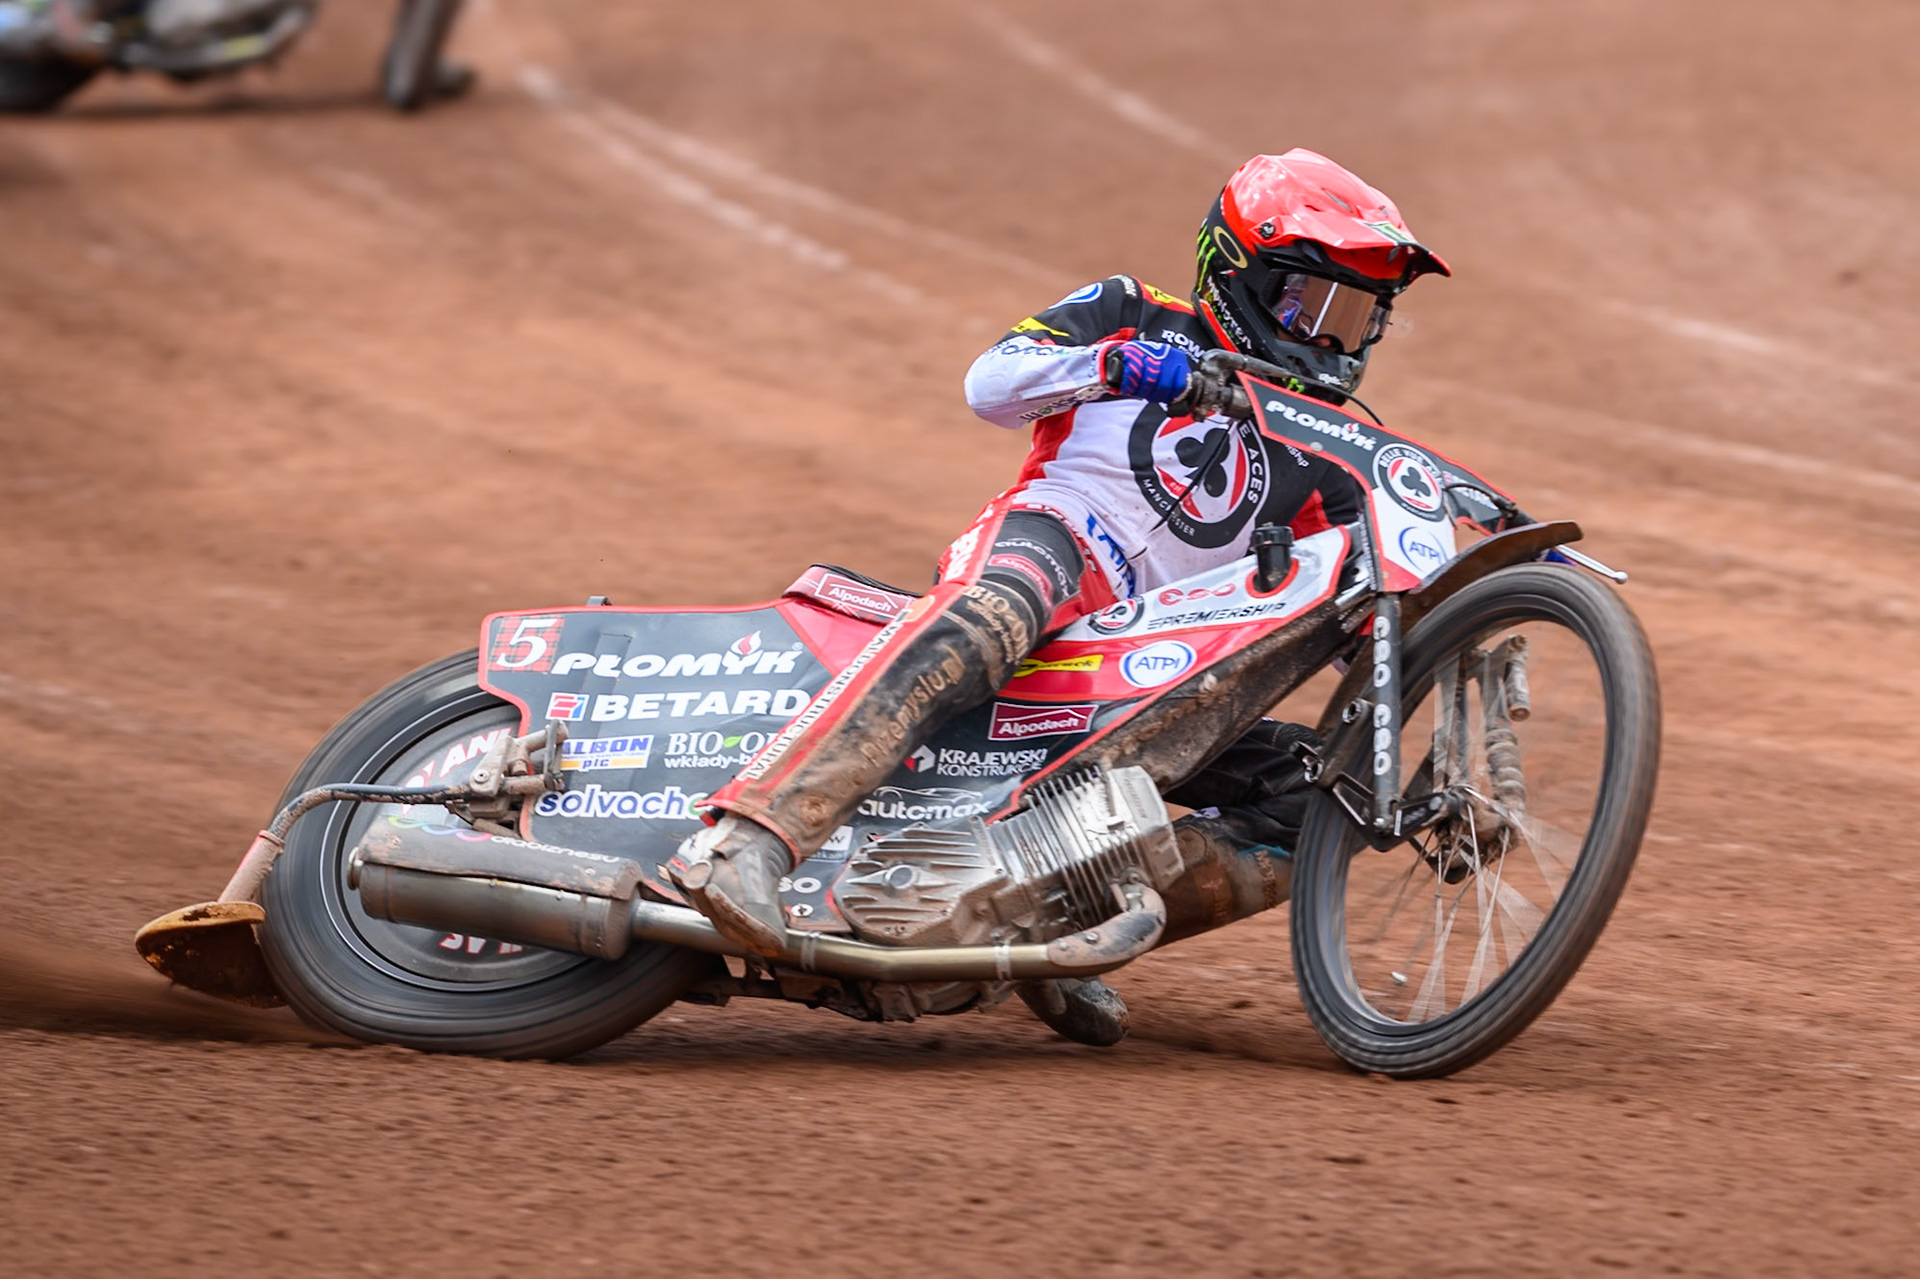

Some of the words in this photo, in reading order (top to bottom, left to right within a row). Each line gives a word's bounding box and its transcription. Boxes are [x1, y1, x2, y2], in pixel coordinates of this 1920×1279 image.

[1161, 329, 1205, 358] ROW
[1247, 447, 1264, 504] ACES
[828, 586, 892, 613] Alpodach
[496, 617, 557, 669] 5
[1134, 655, 1181, 671] ATPI
[590, 689, 811, 722] BETARD
[998, 717, 1079, 737] Alpodach
[582, 758, 610, 769] plc
[939, 747, 1048, 767] KRAJEWSKI
[857, 799, 993, 820] automax
